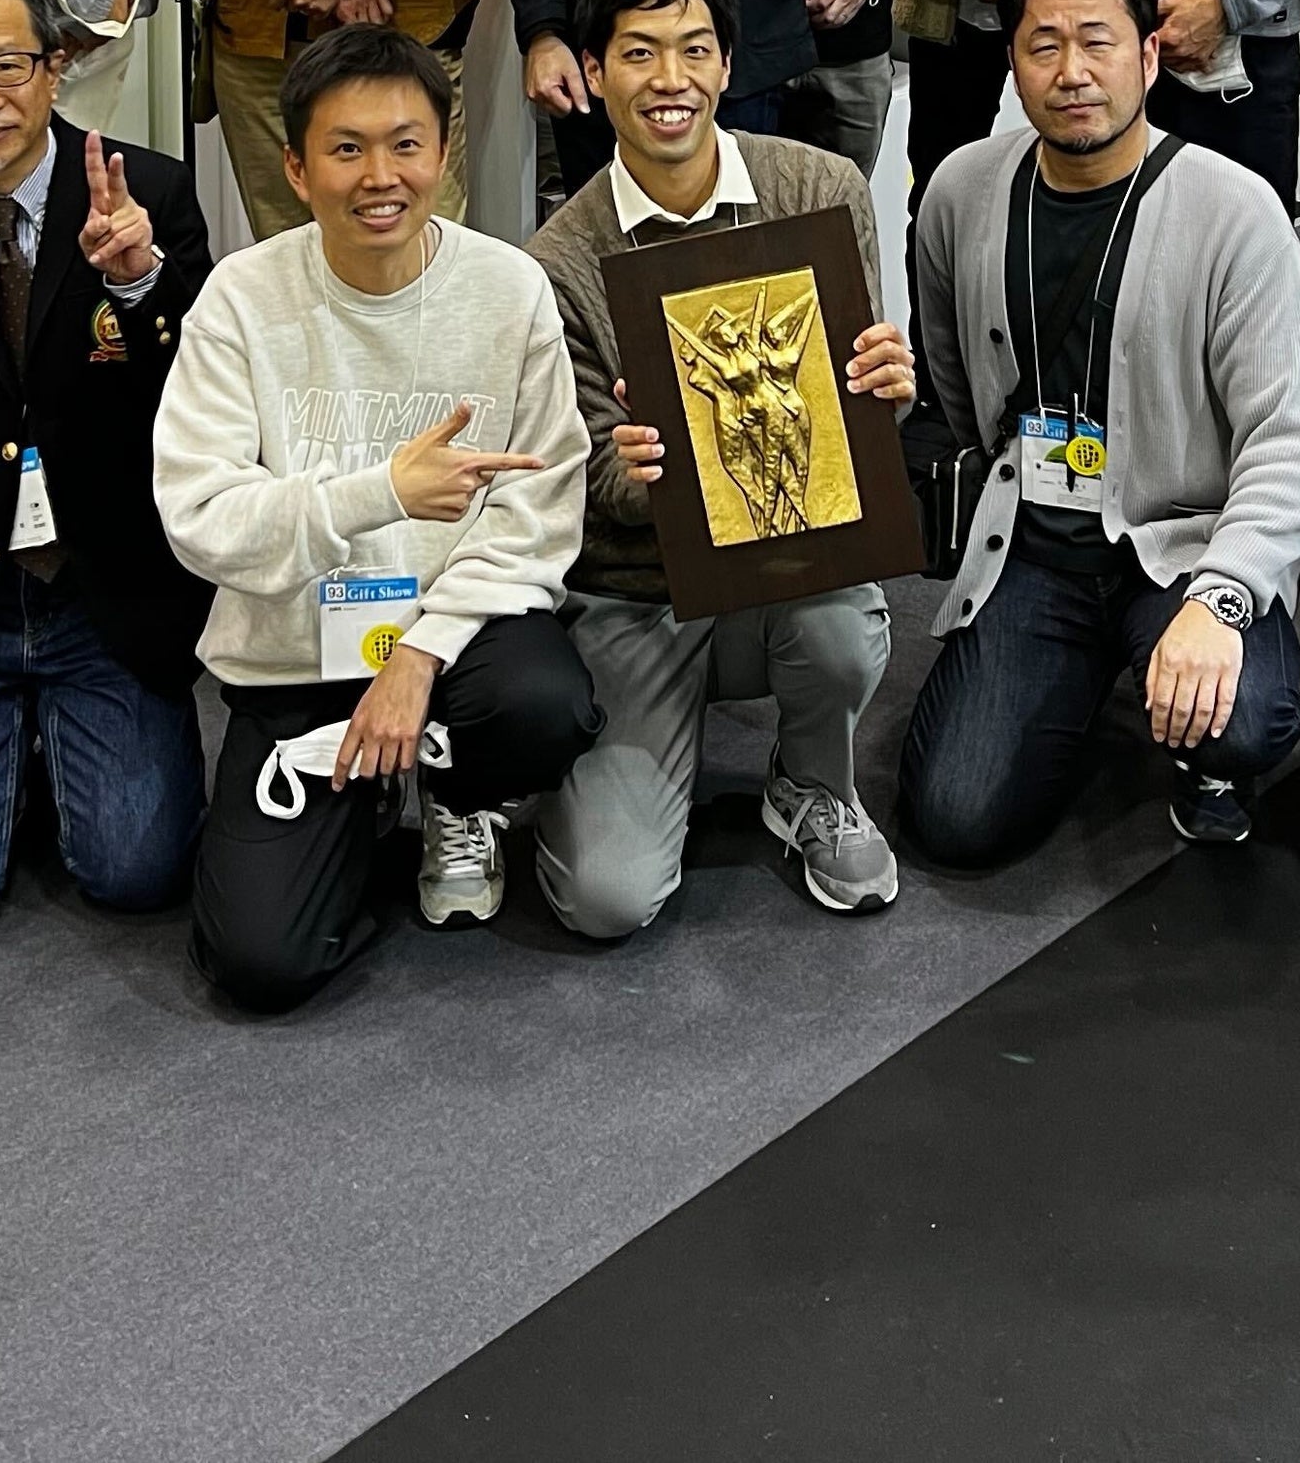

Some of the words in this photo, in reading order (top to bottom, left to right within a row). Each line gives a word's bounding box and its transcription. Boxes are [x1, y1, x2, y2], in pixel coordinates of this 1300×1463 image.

[1027, 421, 1042, 433] 93
[328, 586, 344, 598] 93
[347, 588, 377, 600] Gift
[379, 586, 413, 598] Show
